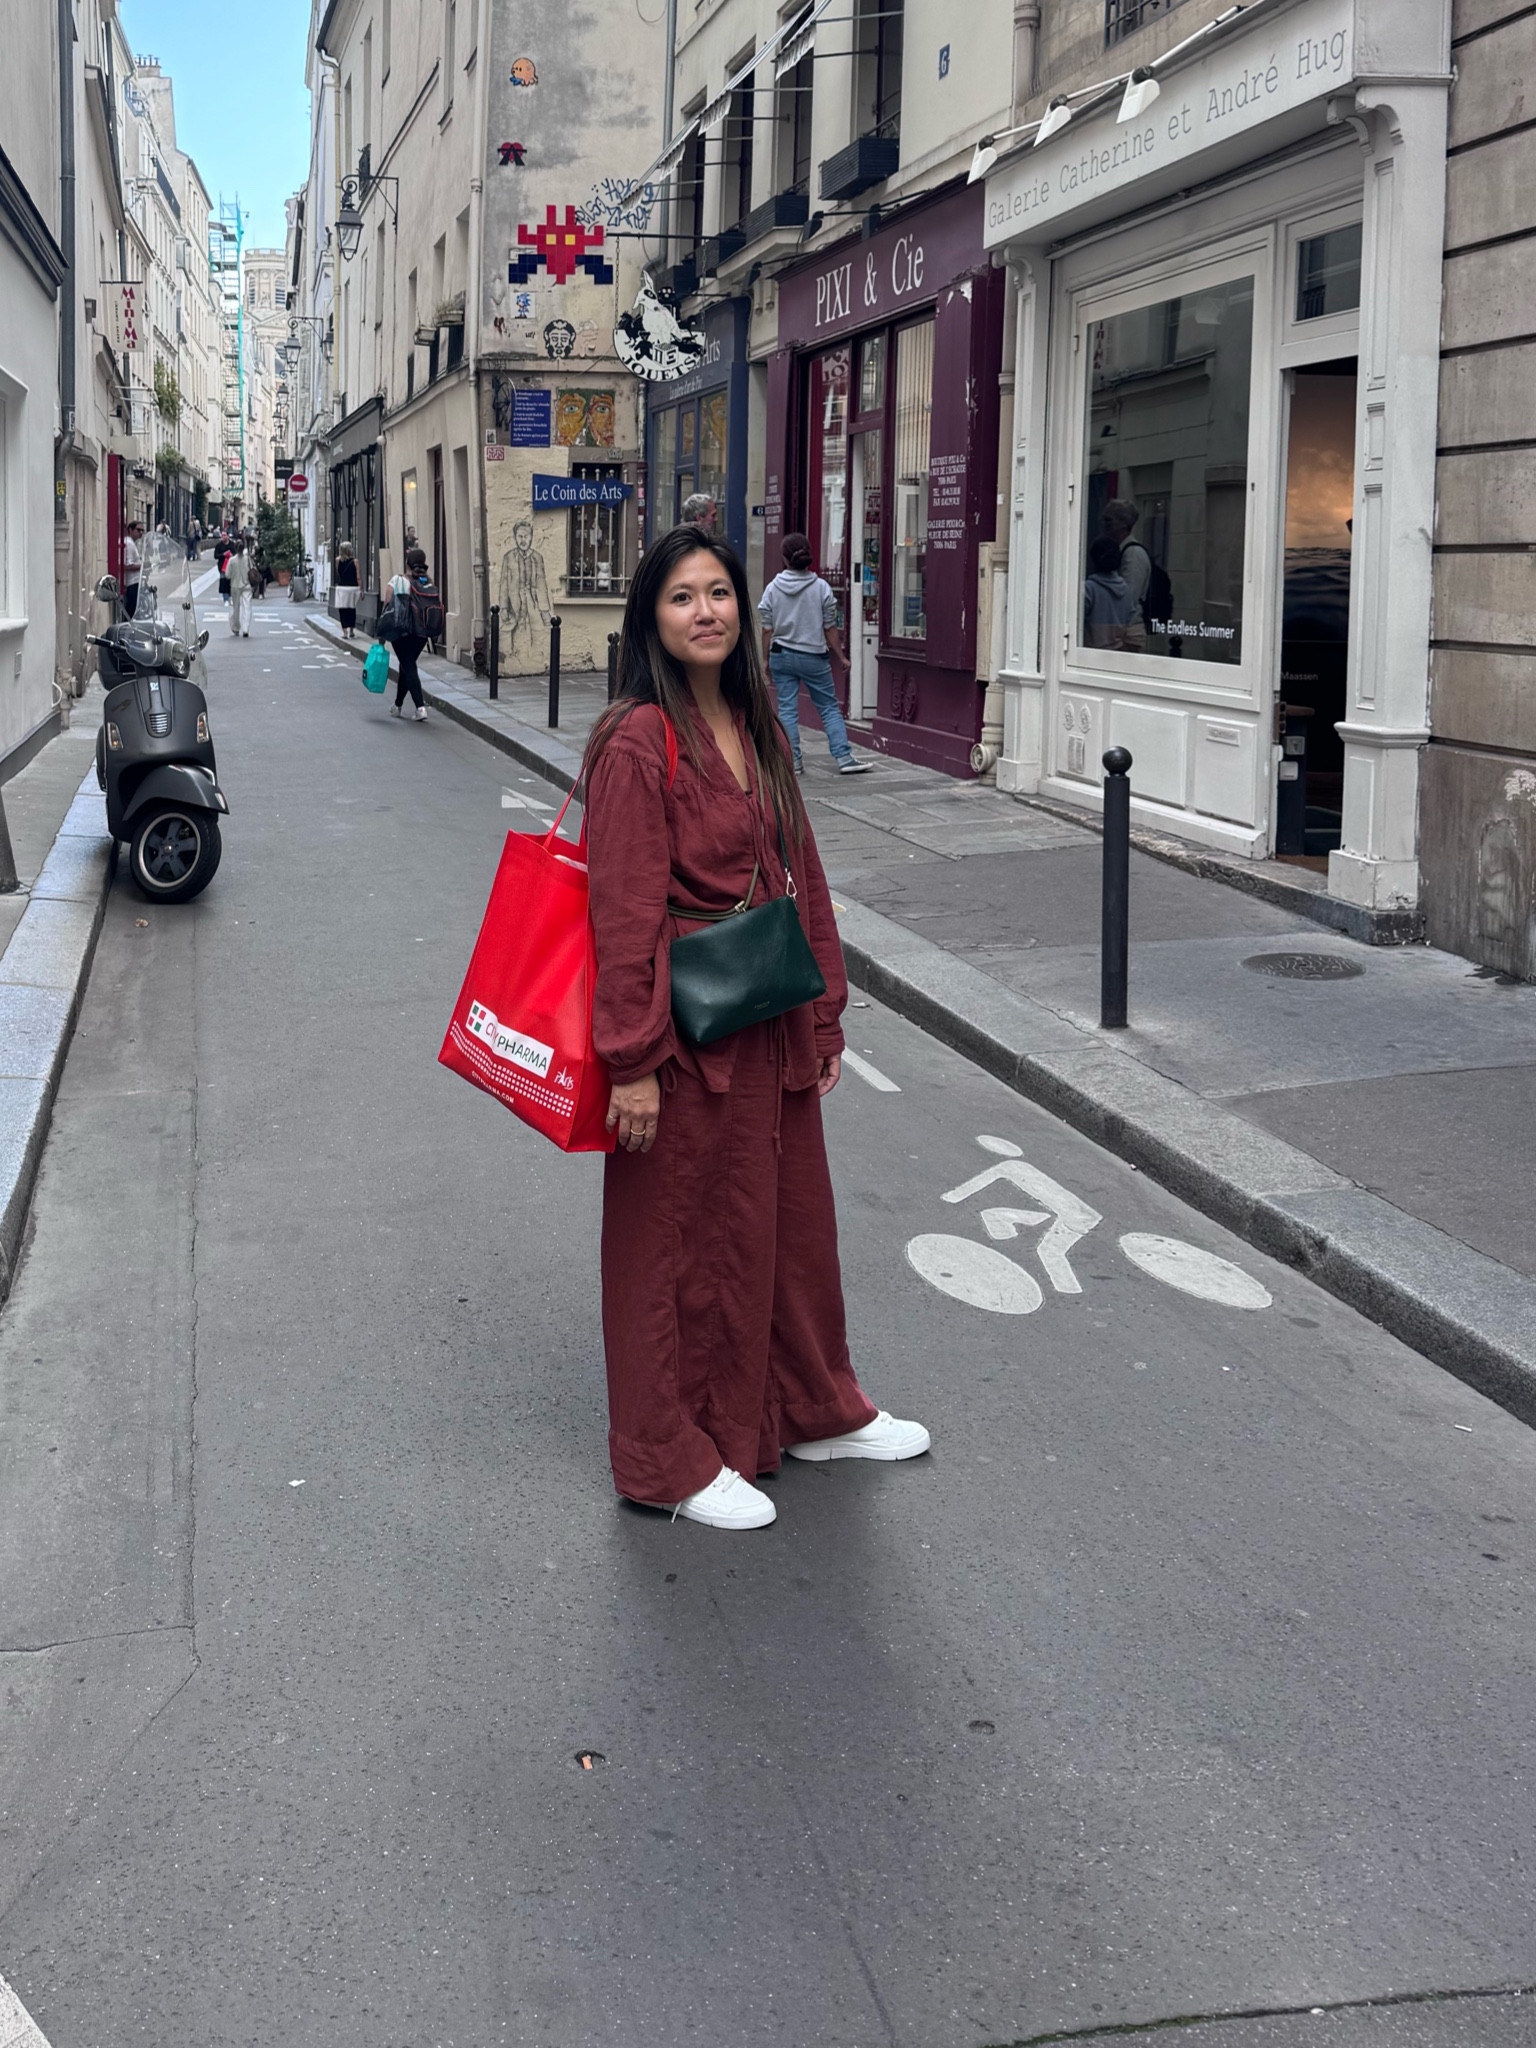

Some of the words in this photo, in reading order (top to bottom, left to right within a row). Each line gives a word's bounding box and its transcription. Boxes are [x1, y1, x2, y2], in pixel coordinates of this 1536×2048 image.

[988, 178, 1049, 228] Galerie
[1059, 127, 1154, 193] Catherine
[1168, 103, 1192, 140] et
[1206, 53, 1278, 123] André
[1296, 30, 1347, 80] Hug
[815, 262, 852, 327] PIXI
[864, 251, 877, 306] &
[892, 233, 924, 296] Cie
[622, 355, 697, 381] JOUETS
[534, 485, 548, 500] Le
[551, 484, 577, 500] Coin
[579, 482, 597, 500] des
[600, 484, 622, 500] Arts
[1151, 618, 1166, 633] The
[1167, 619, 1197, 636] Endless
[1199, 621, 1235, 639] Summer
